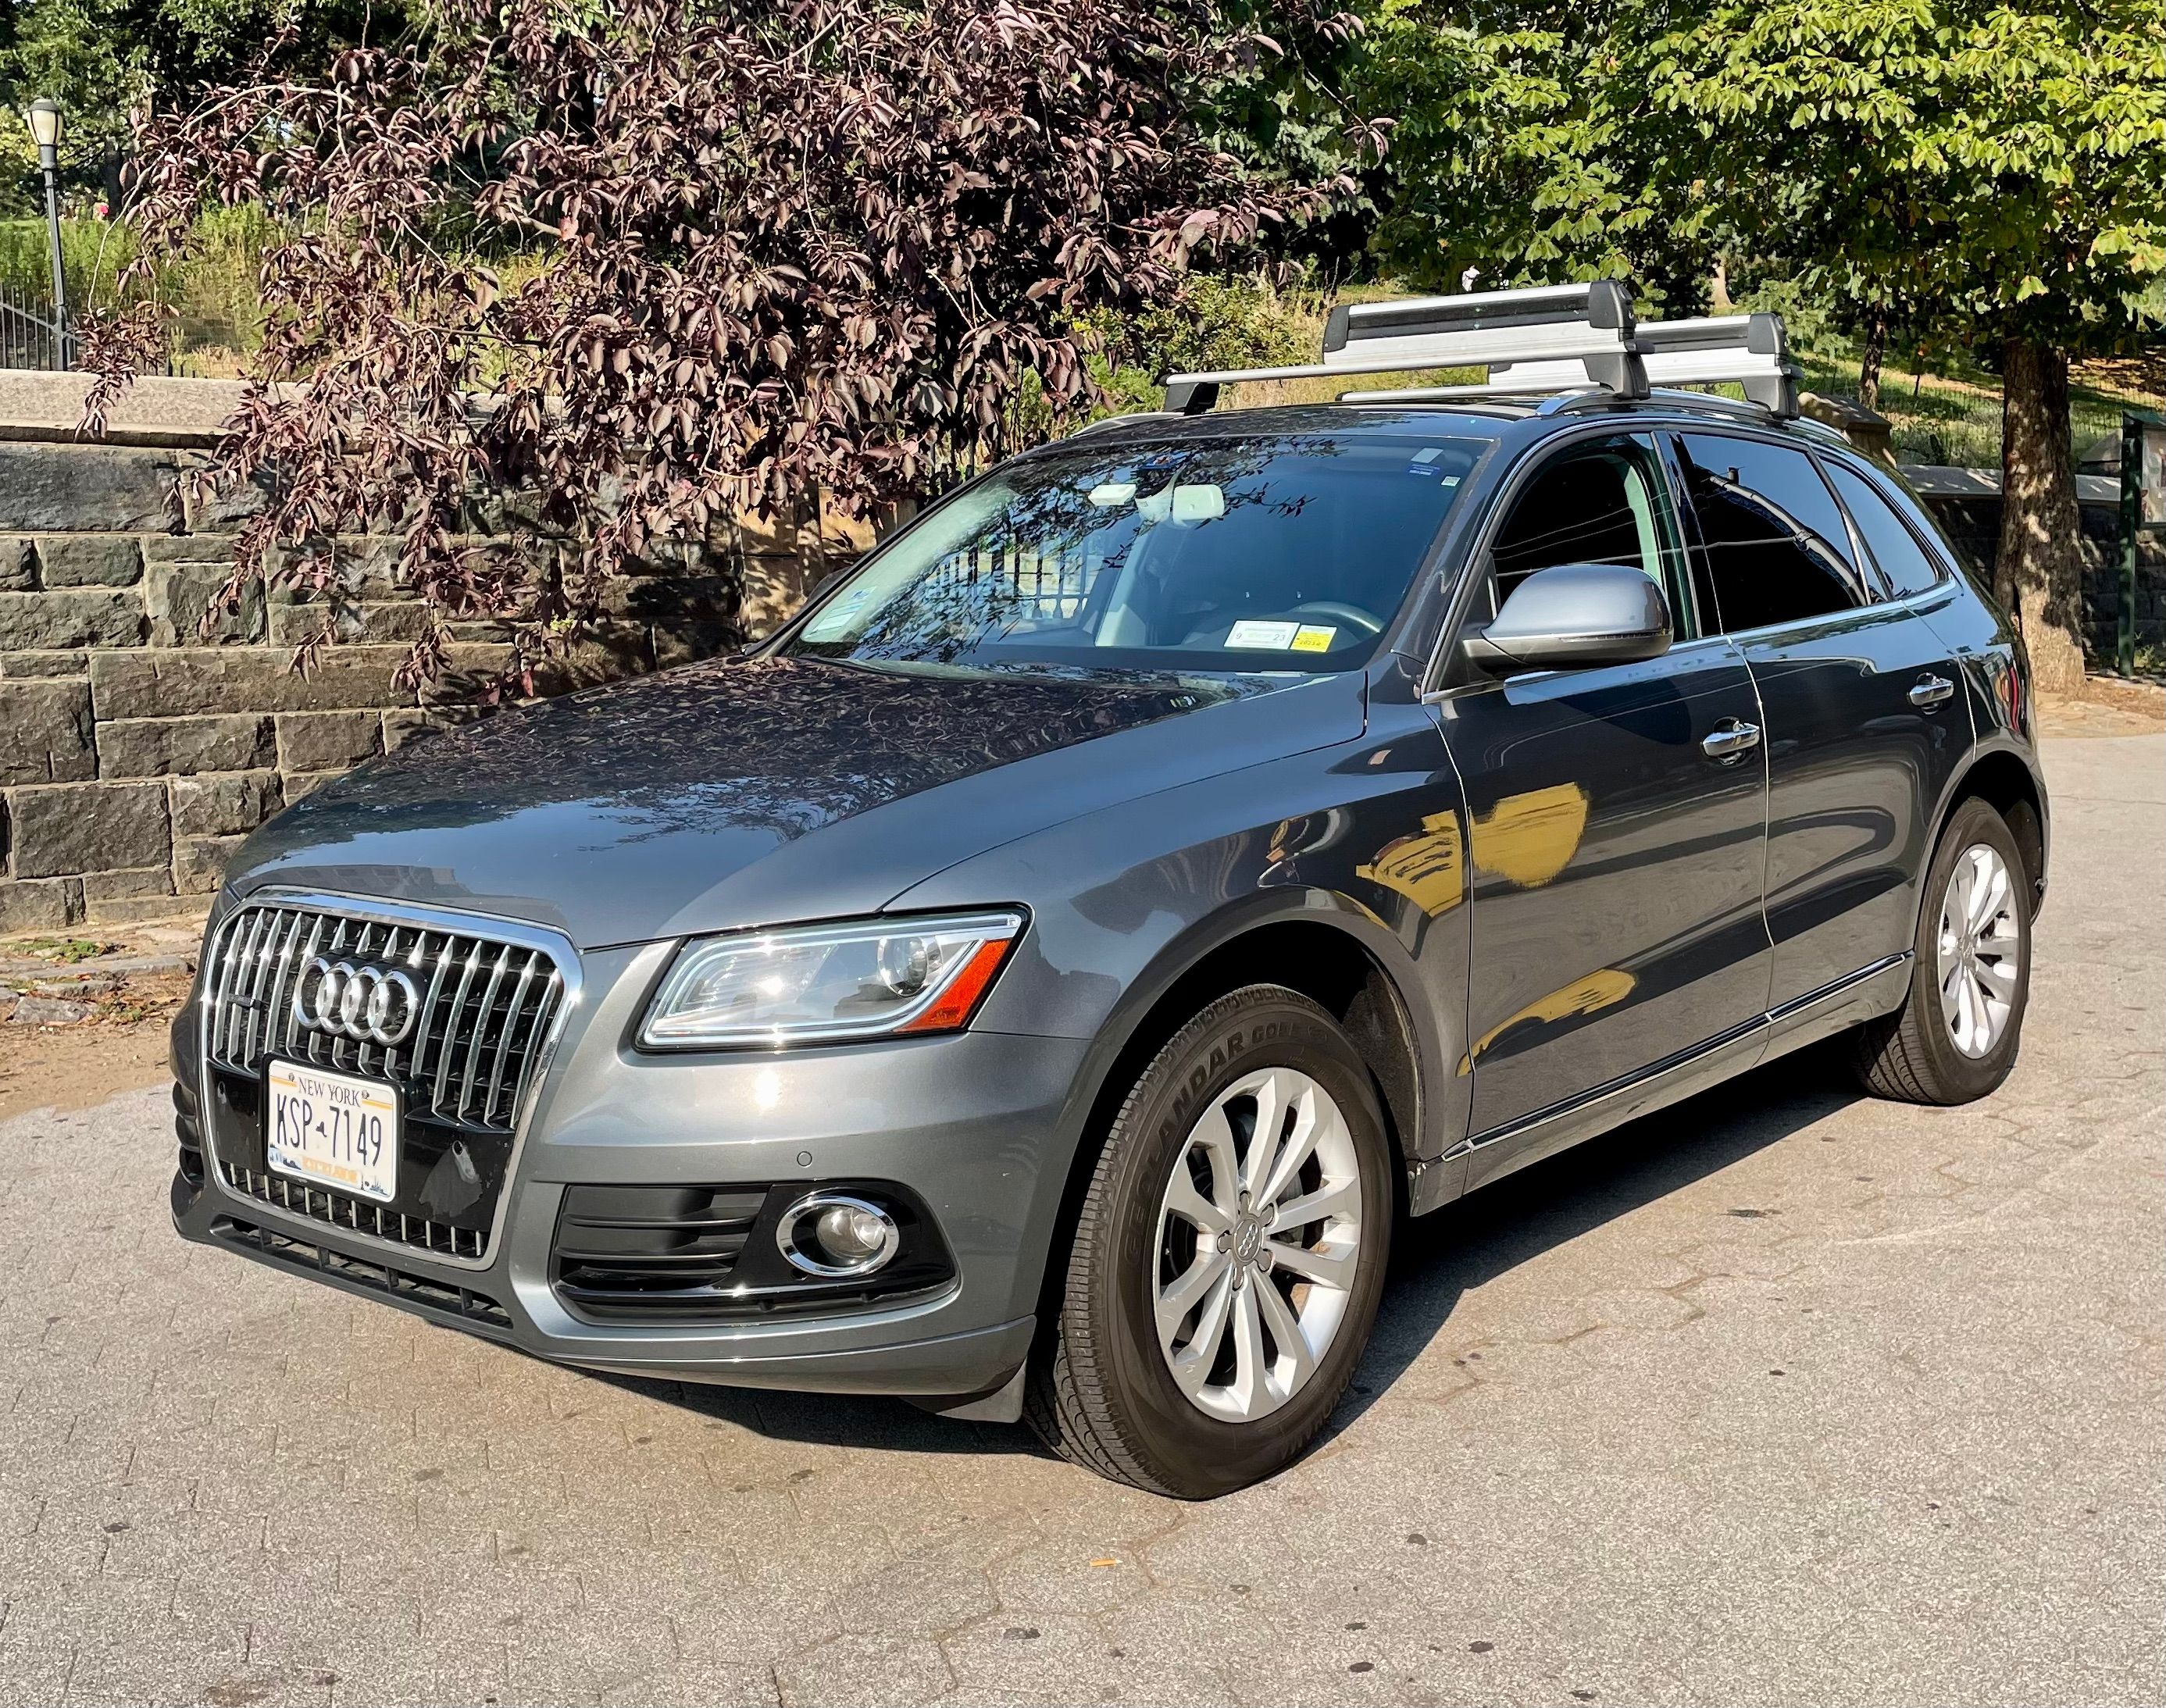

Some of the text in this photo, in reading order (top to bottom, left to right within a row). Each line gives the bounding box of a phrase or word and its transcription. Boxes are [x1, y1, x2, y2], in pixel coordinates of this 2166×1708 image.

[298, 1077, 361, 1107] NEW YORK
[277, 1093, 381, 1166] KSP 7149
